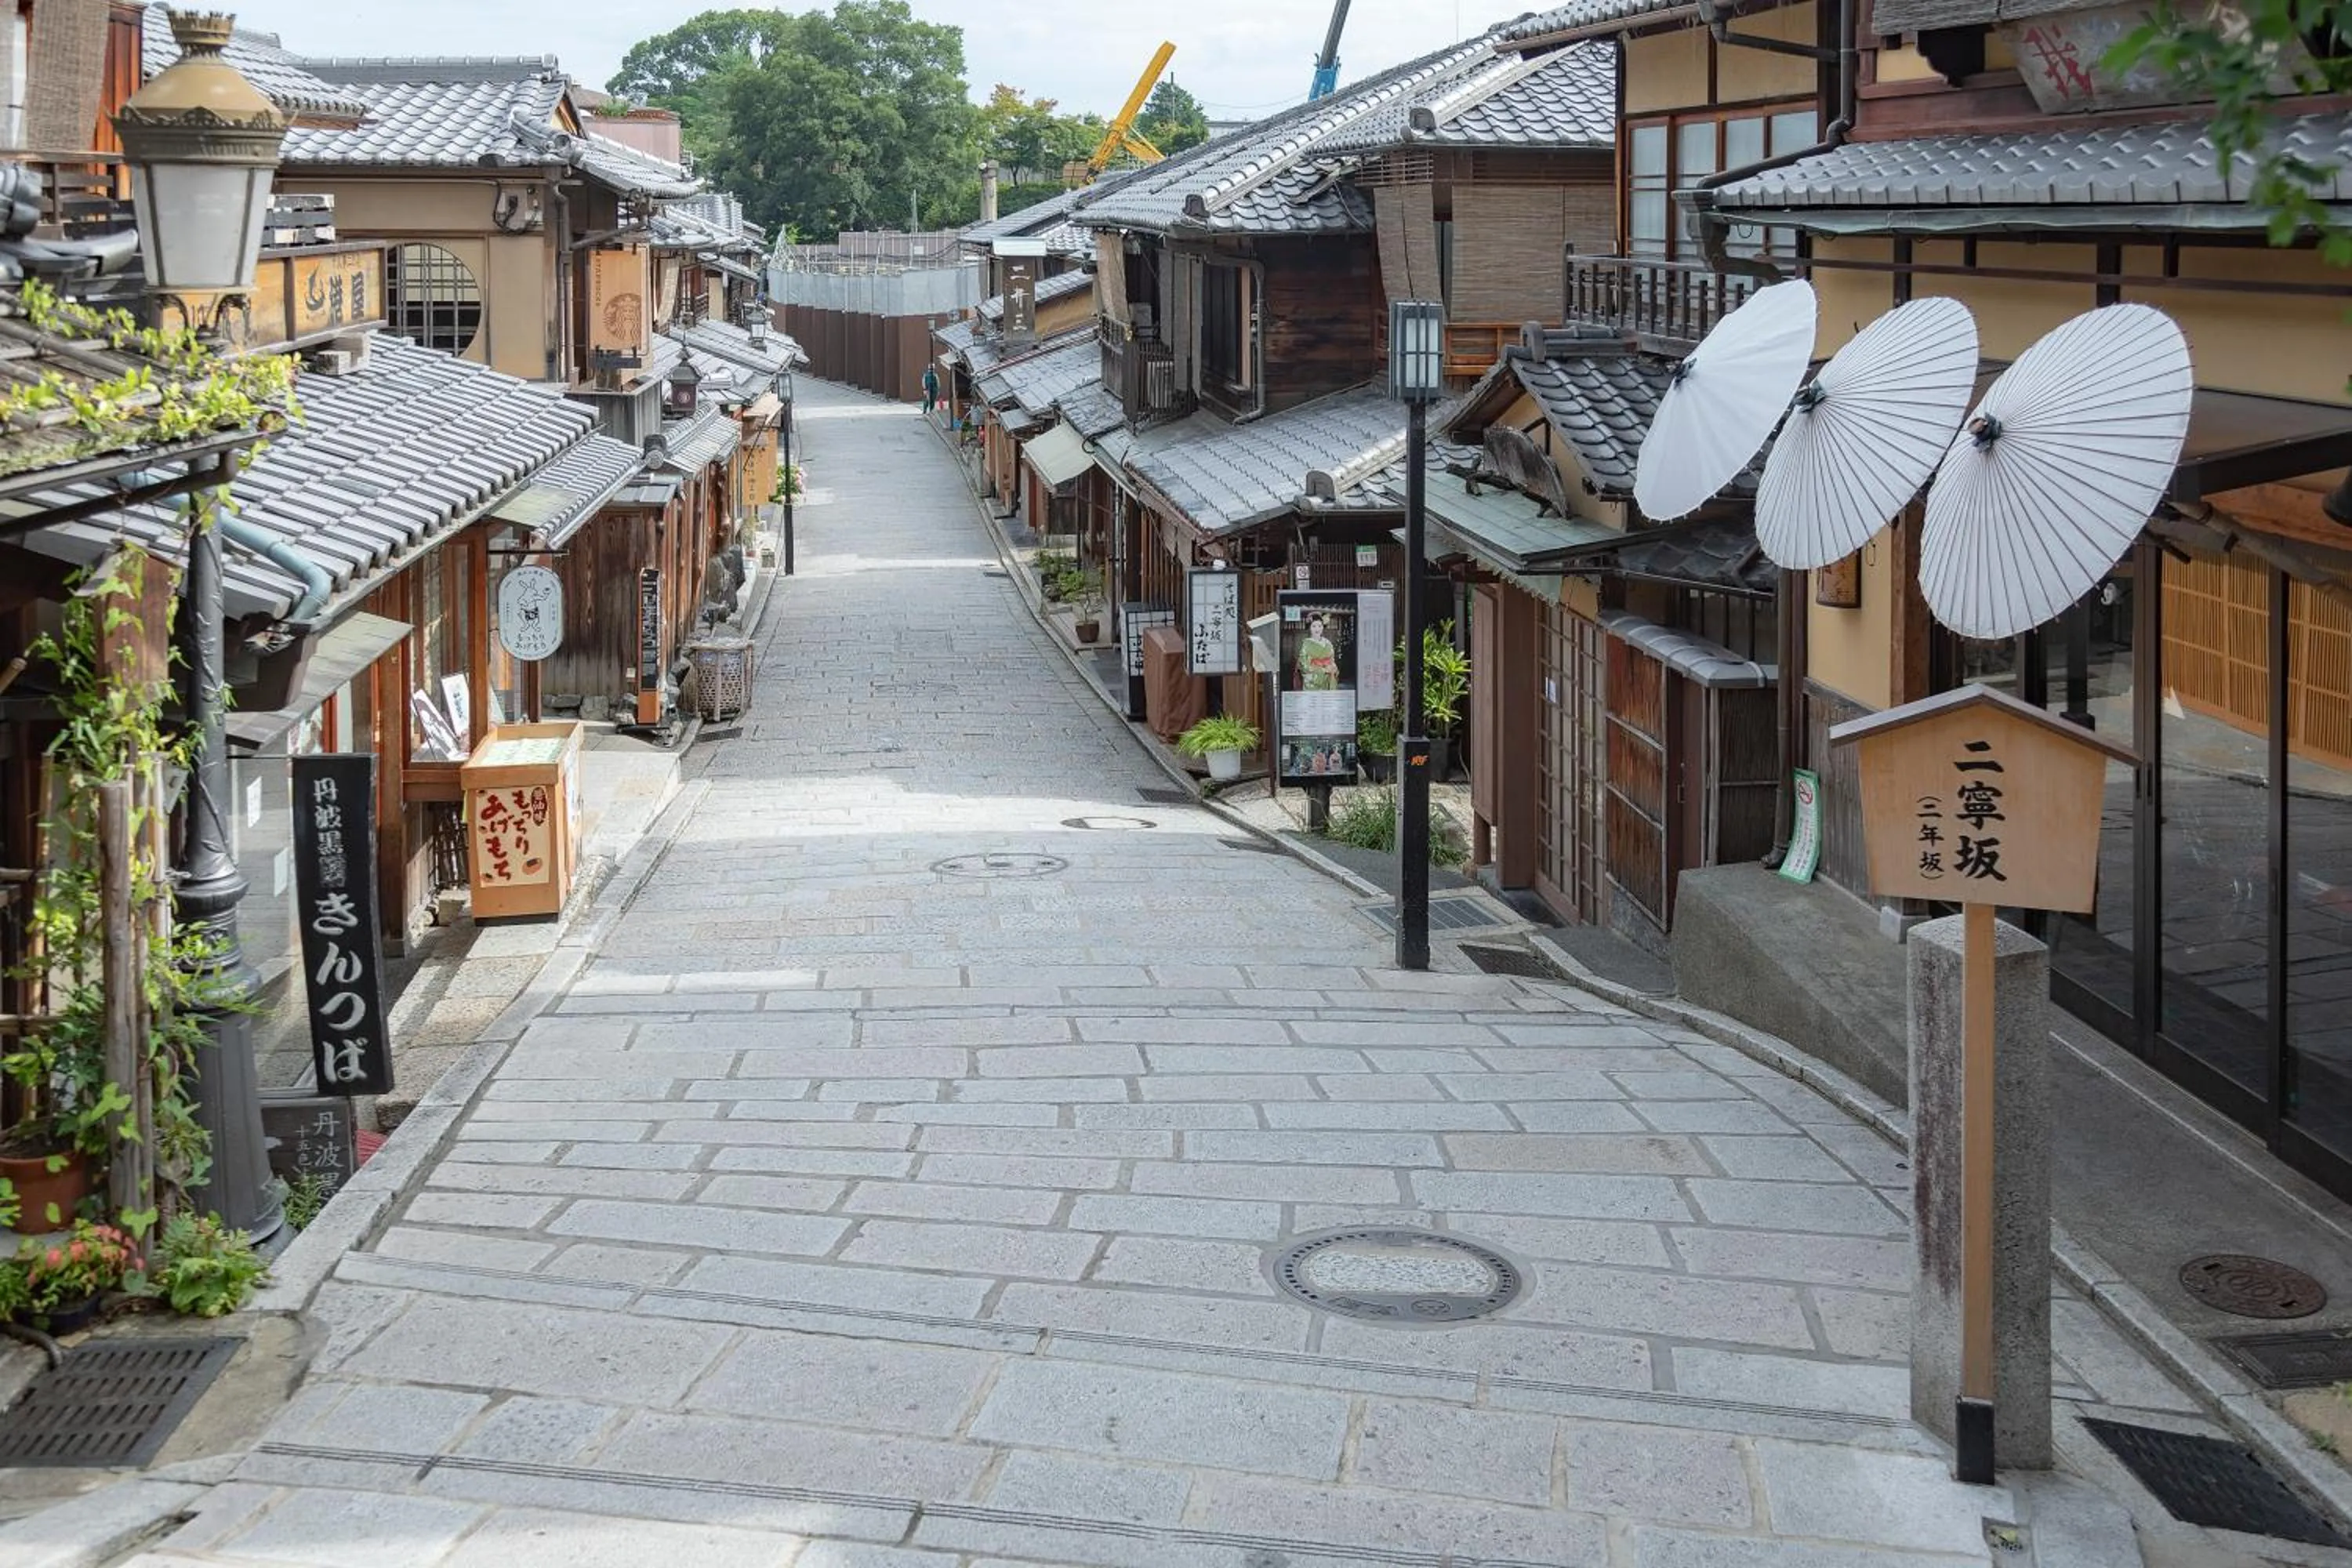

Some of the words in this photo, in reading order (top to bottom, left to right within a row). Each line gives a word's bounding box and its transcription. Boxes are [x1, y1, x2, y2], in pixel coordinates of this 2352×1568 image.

[481, 794, 514, 880] あげもち
[512, 789, 532, 855] もっちり
[1953, 741, 2008, 882] 二寧坂
